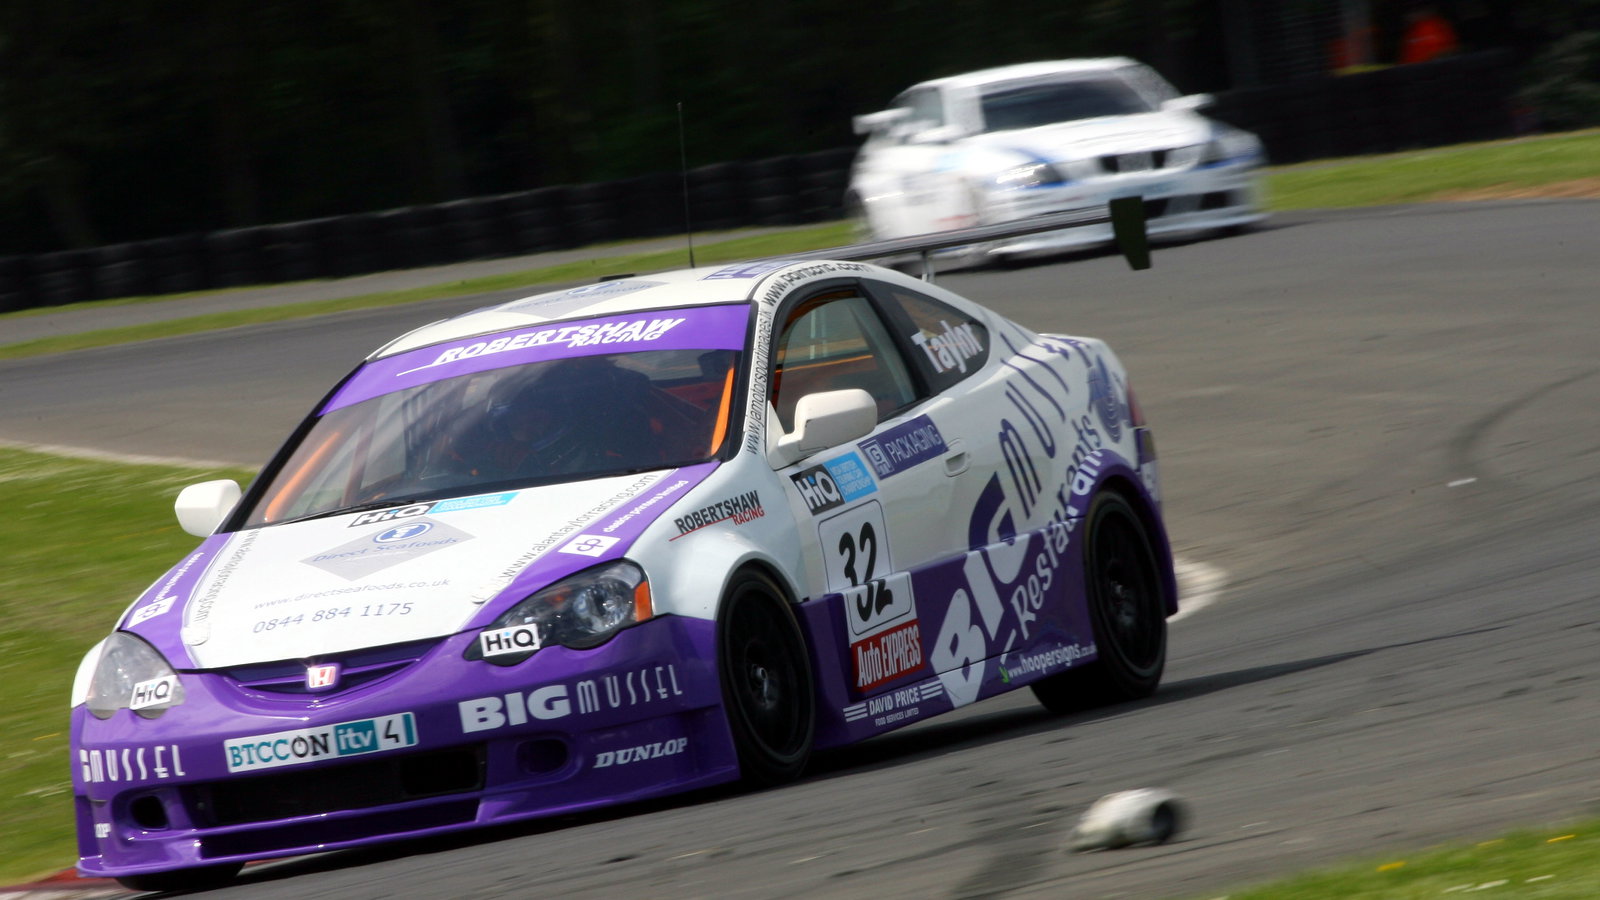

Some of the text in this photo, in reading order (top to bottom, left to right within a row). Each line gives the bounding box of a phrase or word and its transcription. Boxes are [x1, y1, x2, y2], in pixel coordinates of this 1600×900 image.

[435, 318, 685, 364] ROBERTSHAW
[569, 331, 665, 348] RACING
[911, 320, 984, 373] Taylor
[885, 424, 942, 464] PACKAGING
[796, 471, 843, 511] HiQ
[352, 504, 434, 527] HiQ
[673, 490, 762, 535] ROBERTSHAW
[732, 506, 765, 526] RACING
[312, 536, 458, 563] Direct Seafoods
[839, 522, 893, 622] 32
[254, 579, 451, 610] www.directseafoods.co.uk
[253, 601, 415, 634] 0844 884 1175
[484, 628, 536, 652] HiQ
[857, 624, 922, 688] Auto EXPRESS
[133, 679, 170, 706] HiQ
[458, 665, 683, 734] BIG MUSSEL
[869, 687, 921, 716] DAVID PRICE
[337, 727, 374, 751] itv
[384, 719, 400, 744] 4
[90, 744, 186, 783] MUSSEL
[592, 737, 688, 769] DUNLOP
